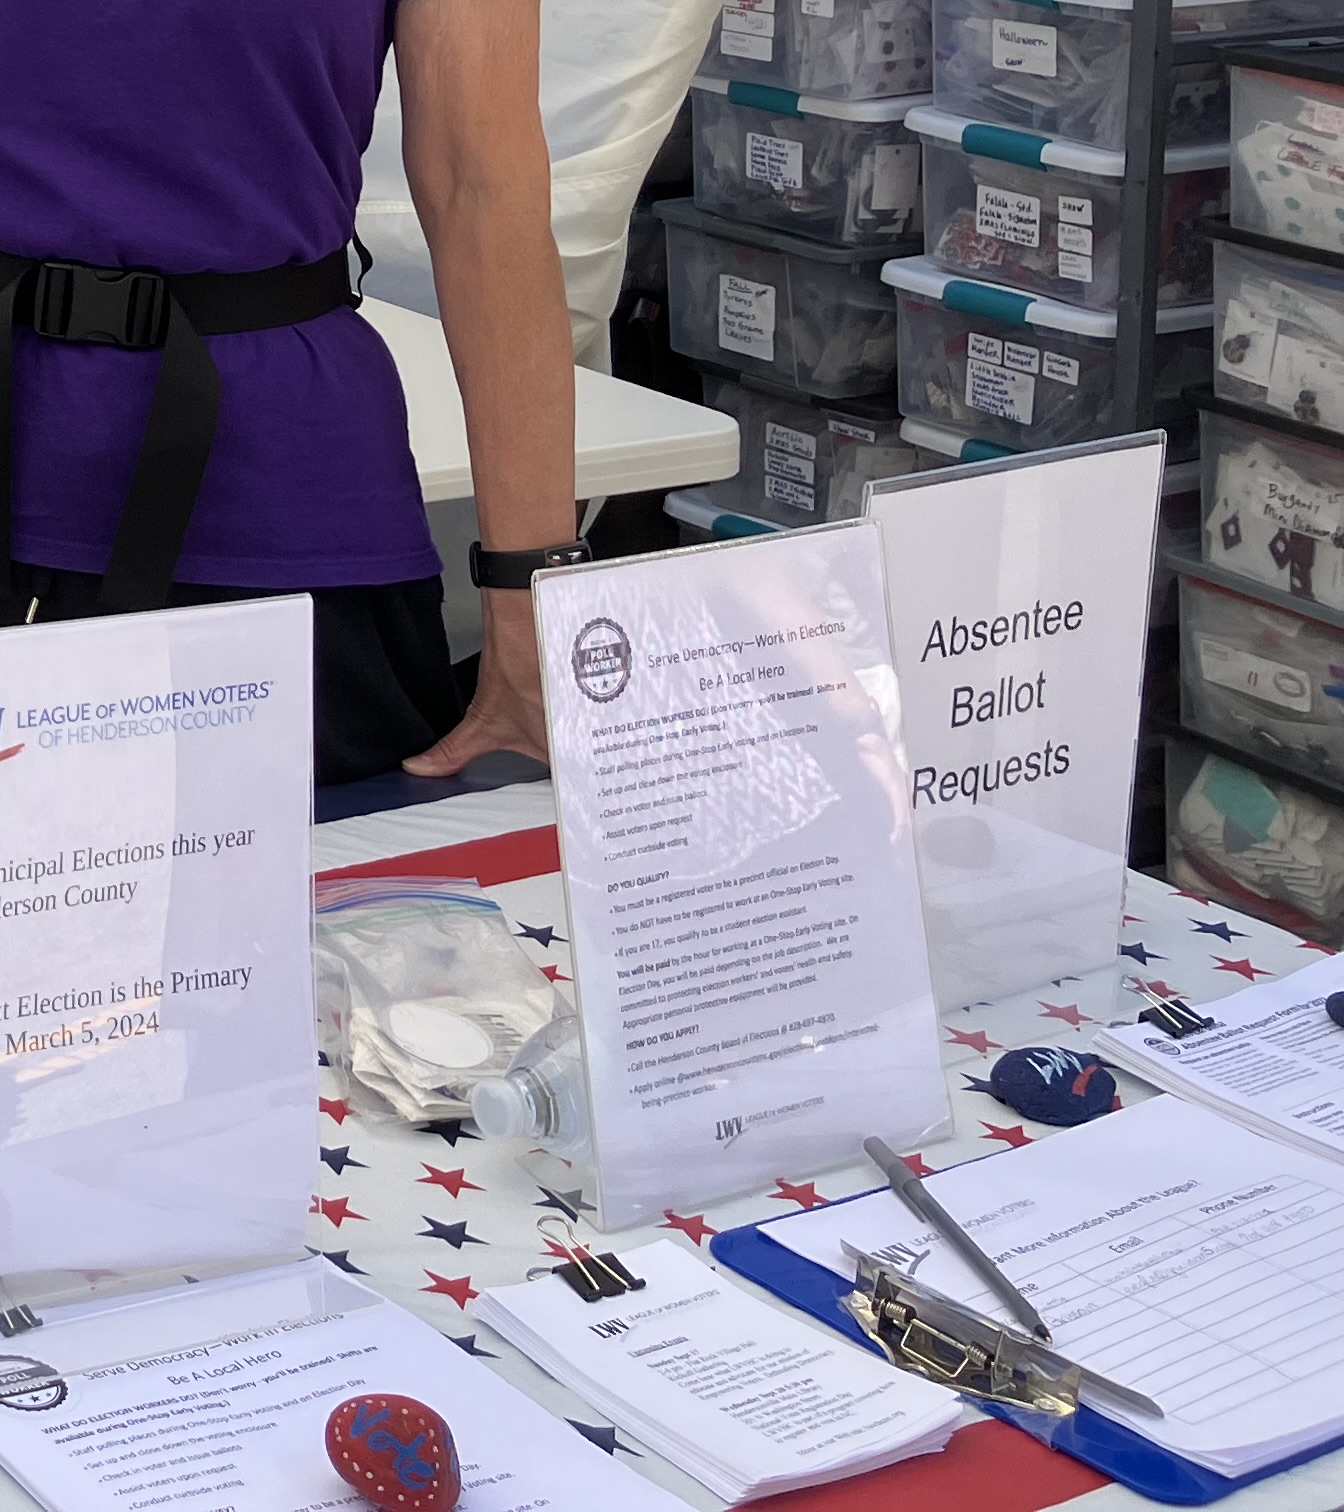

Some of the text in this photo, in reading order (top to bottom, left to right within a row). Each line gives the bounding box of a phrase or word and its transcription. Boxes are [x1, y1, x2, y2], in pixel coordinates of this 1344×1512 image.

[647, 621, 846, 669] Serve Democracy—Work in Elections
[920, 599, 1083, 662] Absentee
[699, 665, 786, 692] Be A Local Hero
[951, 670, 1046, 728] Ballot
[17, 681, 270, 729] LEAGUE OF WOMEN VOTERS
[38, 703, 256, 749] OF HENDERSON COUNTY
[913, 739, 1070, 809] Requests
[72, 842, 165, 872] Elections
[172, 832, 207, 857] this
[212, 829, 256, 857] year
[64, 881, 138, 907] County
[16, 988, 103, 1018] Election
[110, 981, 126, 1004] is
[134, 976, 165, 1000] the
[170, 966, 252, 994] Primary
[4, 1023, 75, 1056] March
[81, 1020, 100, 1046] 5,
[106, 1011, 160, 1041] 2024
[1011, 1239, 1045, 1256] More
[1043, 1215, 1108, 1245] Information
[1105, 1201, 1139, 1220] About
[1109, 1235, 1144, 1255] Email
[1199, 1198, 1237, 1215] Phone
[167, 1350, 282, 1386] Be A Local Hero
